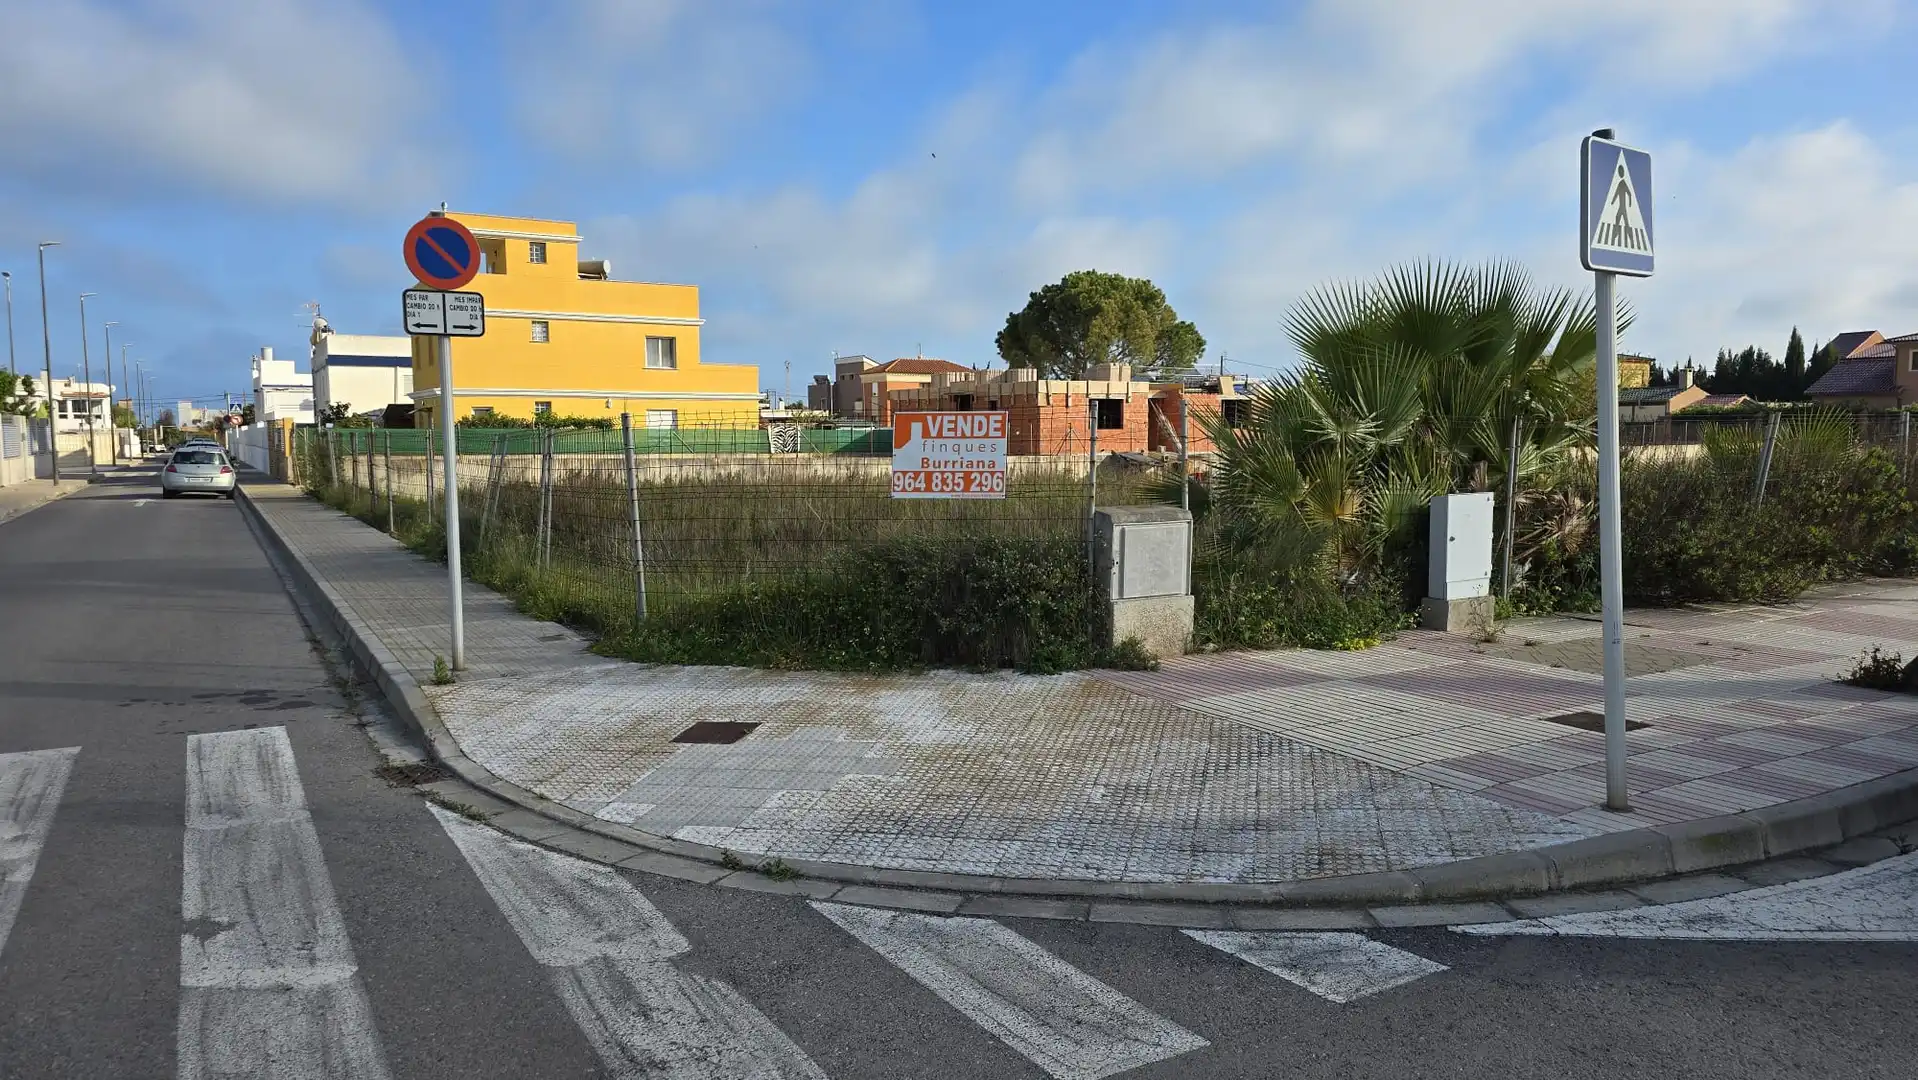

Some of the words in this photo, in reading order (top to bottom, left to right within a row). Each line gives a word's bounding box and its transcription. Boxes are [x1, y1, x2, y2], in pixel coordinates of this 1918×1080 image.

[926, 415, 1002, 437] VENDE
[922, 440, 997, 455] finques
[921, 457, 996, 469] Burriana
[894, 472, 926, 492] 964
[932, 472, 964, 492] 835
[970, 472, 1003, 492] 296
